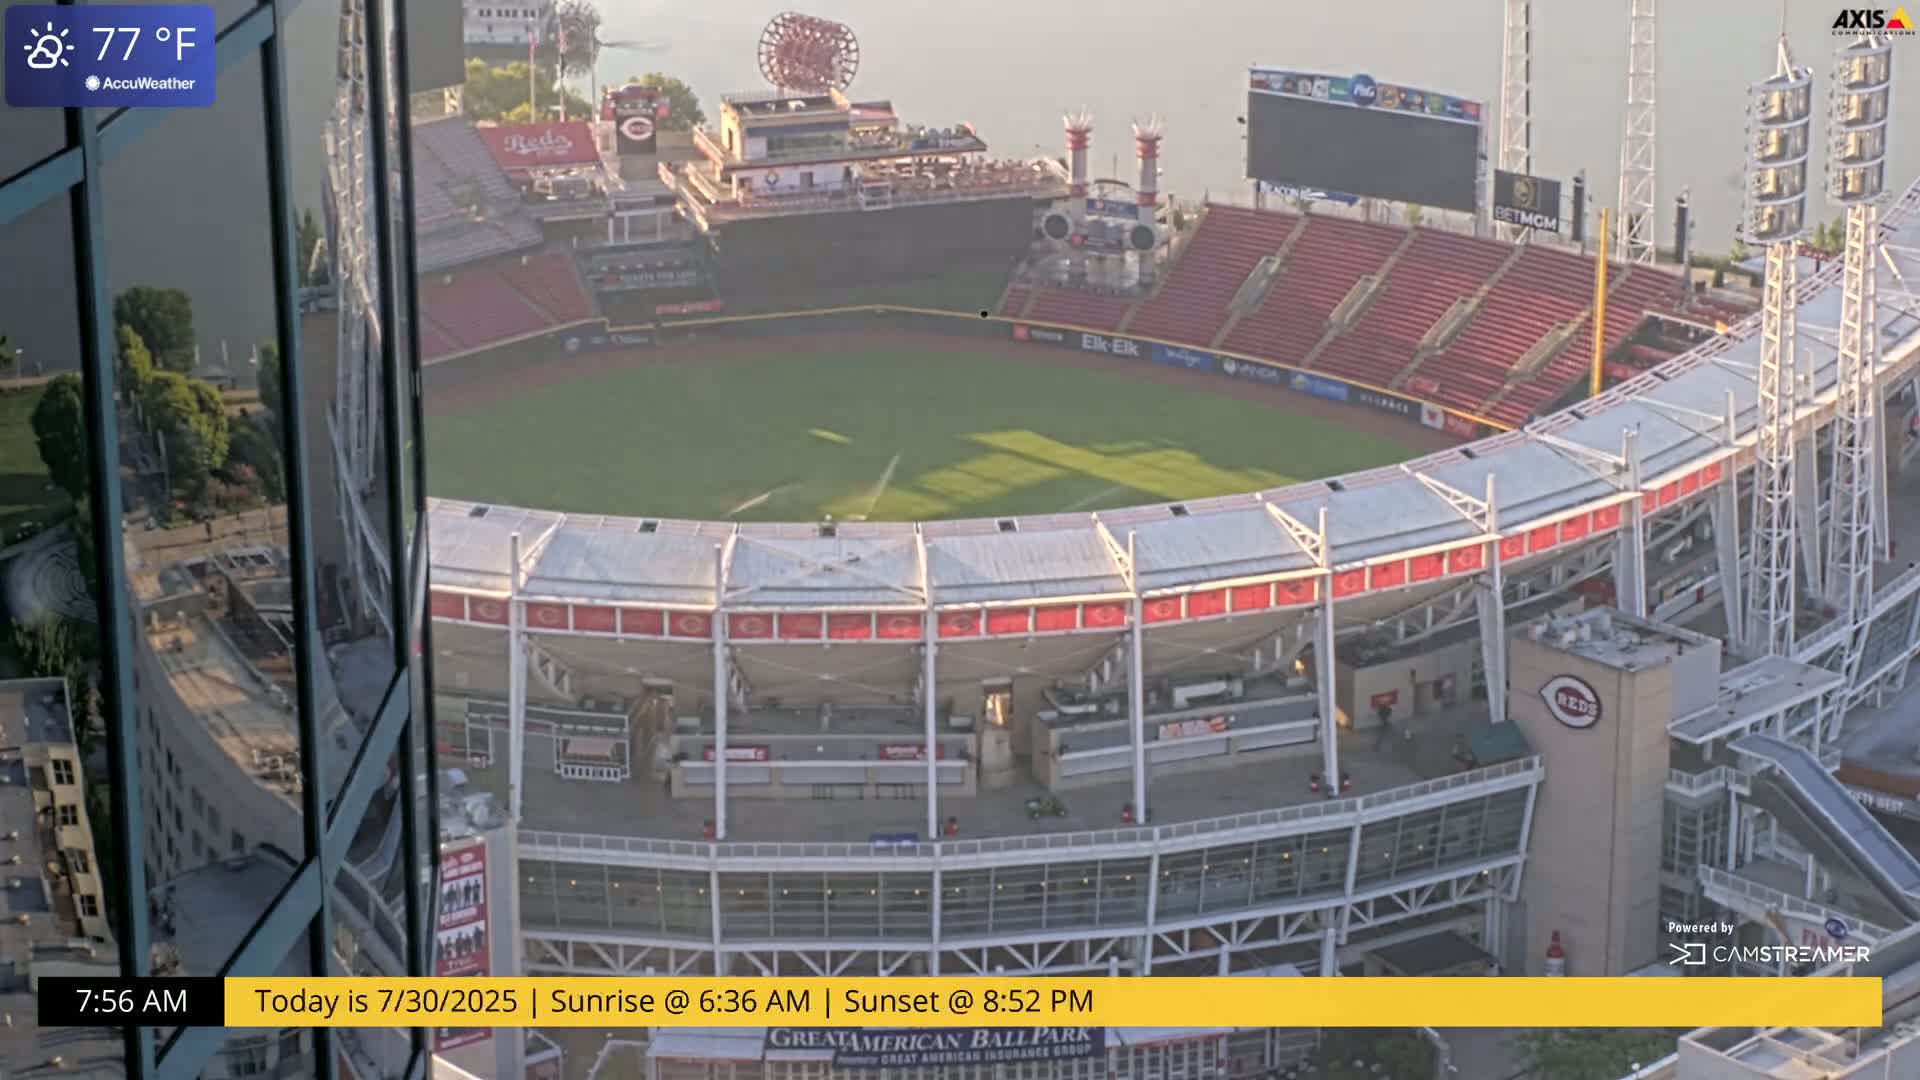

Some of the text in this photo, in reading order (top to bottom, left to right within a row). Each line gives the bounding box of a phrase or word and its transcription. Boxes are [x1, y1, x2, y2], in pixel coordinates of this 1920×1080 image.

[503, 130, 573, 154] Reds
[1495, 206, 1557, 230] BETMGM
[1557, 692, 1598, 716] REDS
[881, 1053, 917, 1065] GREAT
[921, 1050, 981, 1063] AMERICAN
[985, 1047, 1049, 1061] INSURANCE
[1053, 1043, 1092, 1056] GROUP
